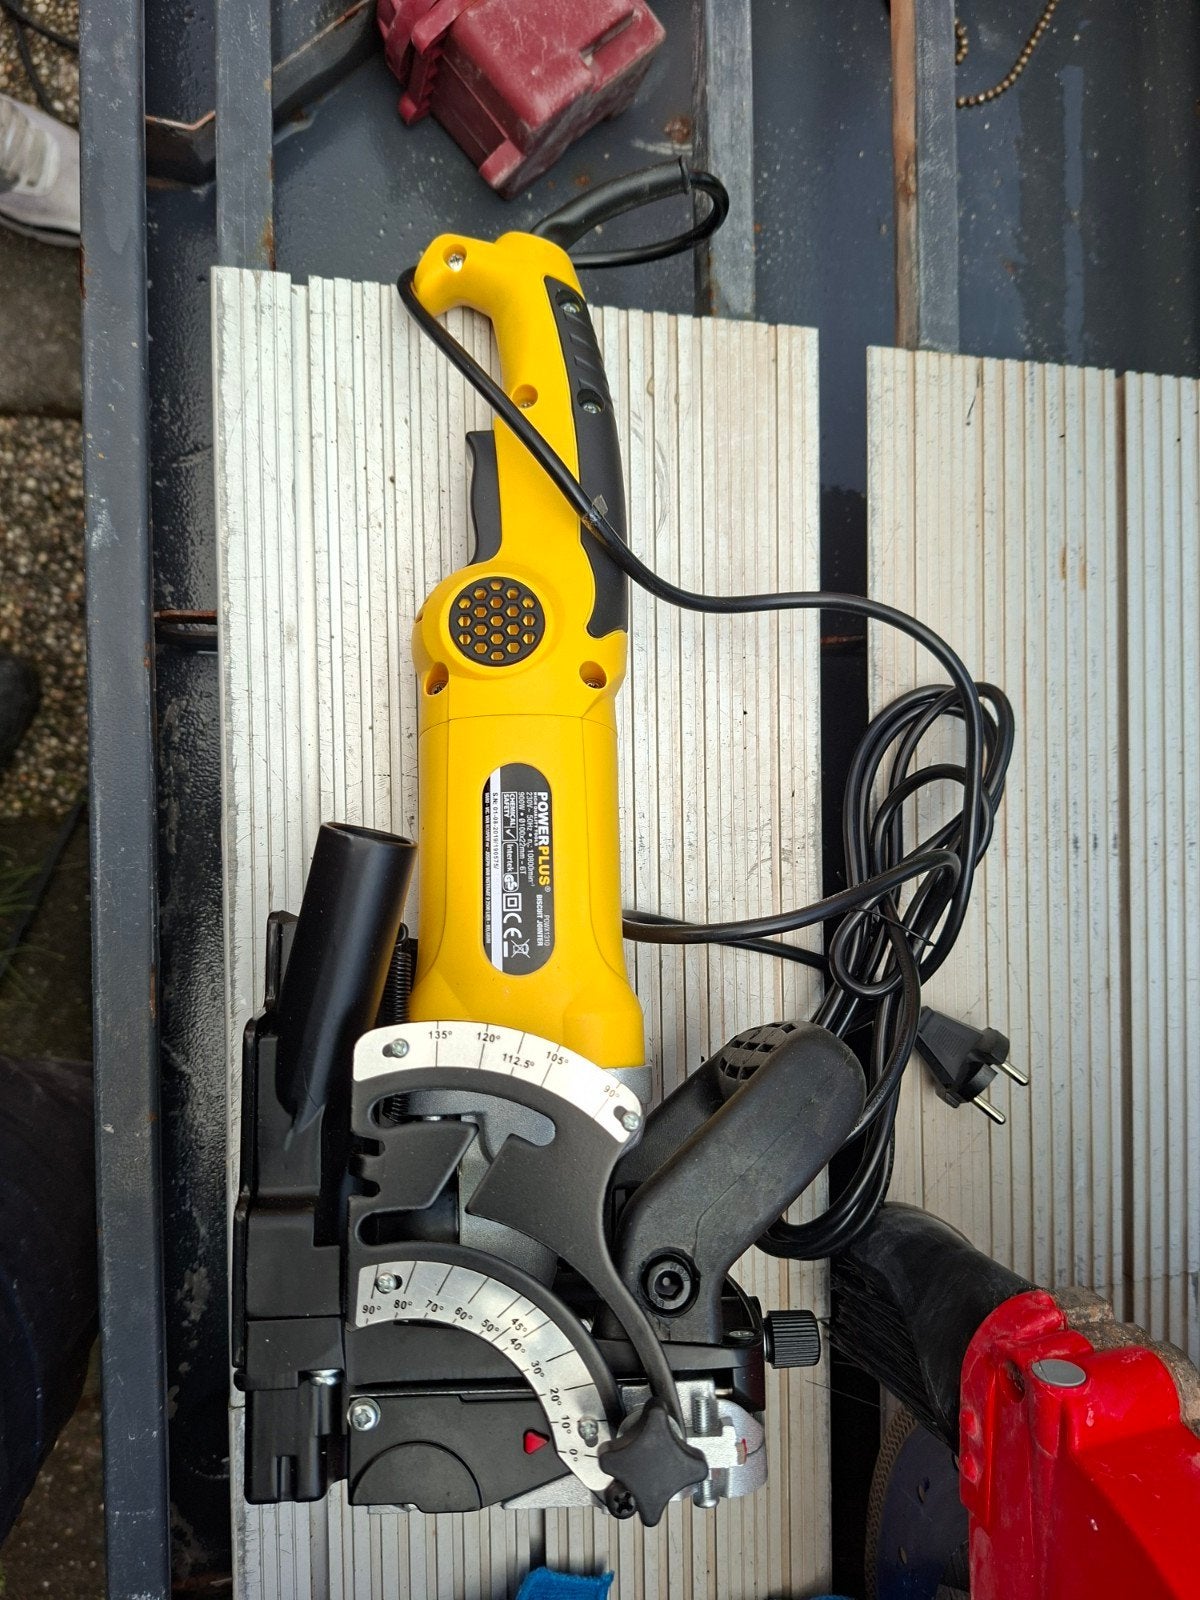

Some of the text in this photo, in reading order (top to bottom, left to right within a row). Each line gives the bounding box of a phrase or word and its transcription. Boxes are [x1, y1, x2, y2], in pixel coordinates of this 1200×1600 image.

[506, 844, 514, 872] Intertek
[520, 866, 527, 875] 6T
[428, 1030, 453, 1040] 135°
[476, 1032, 501, 1043] 120°
[502, 1052, 535, 1069] 112.5°
[545, 1050, 569, 1066] 105°
[362, 1304, 382, 1314] 90°
[393, 1299, 413, 1310] 80°
[426, 1300, 444, 1312] 70°
[454, 1306, 474, 1320] 60°
[480, 1318, 500, 1332] 50°
[510, 1318, 528, 1333] 45°
[510, 1337, 526, 1354] 40°
[530, 1359, 545, 1378] 30°
[549, 1387, 562, 1406] 20°
